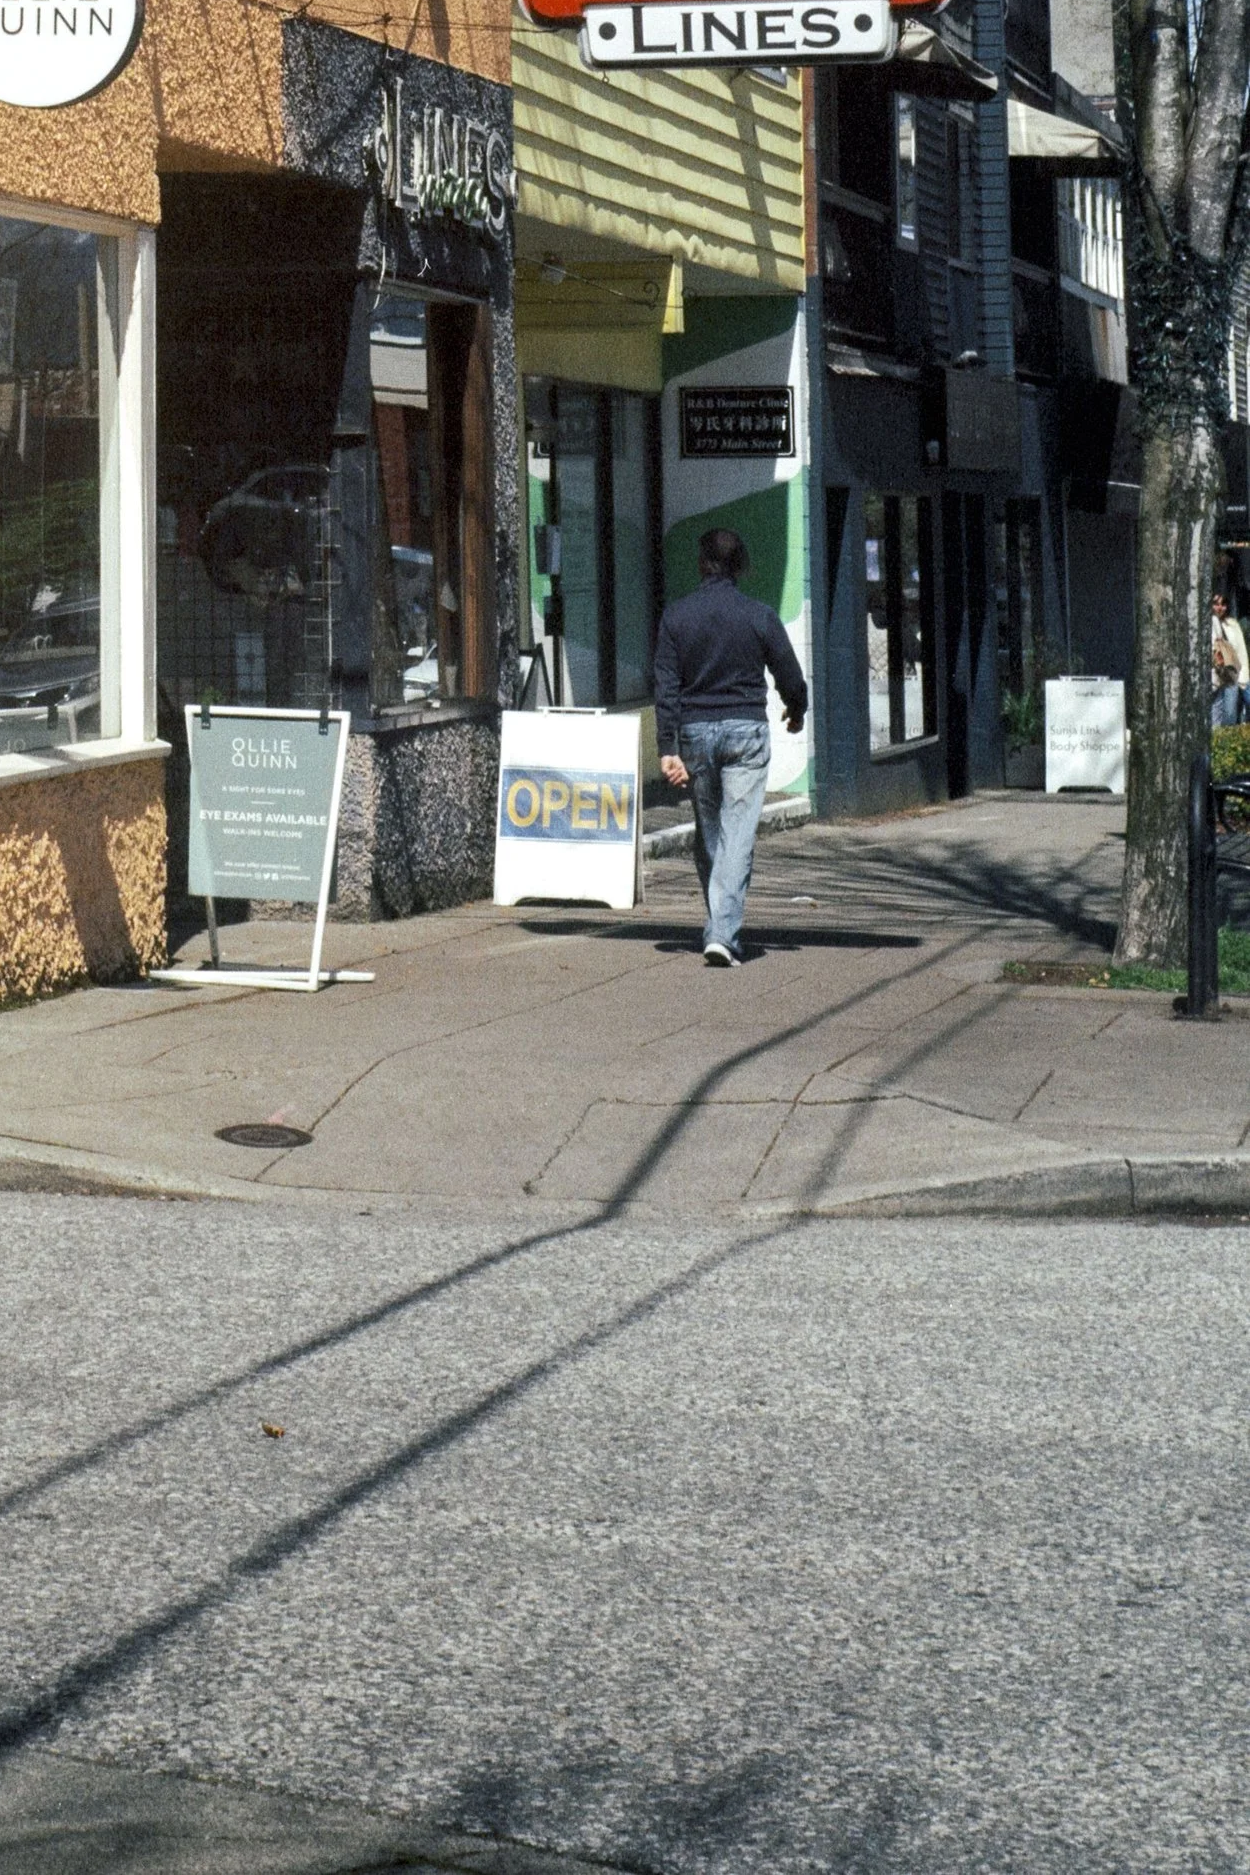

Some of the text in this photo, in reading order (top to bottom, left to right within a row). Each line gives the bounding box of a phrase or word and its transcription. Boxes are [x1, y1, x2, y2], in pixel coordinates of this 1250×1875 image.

[630, 5, 841, 54] LINES
[721, 438, 749, 449] Main
[751, 437, 782, 449] Street
[1081, 725, 1101, 735] Link
[232, 737, 291, 754] OLLIE
[1050, 740, 1121, 754] Body Shoppe
[231, 753, 297, 769] QUINN
[506, 778, 629, 832] OPEN
[199, 809, 328, 826] EYE EXAMS AVAILABLE
[263, 829, 303, 839] WELCOME
